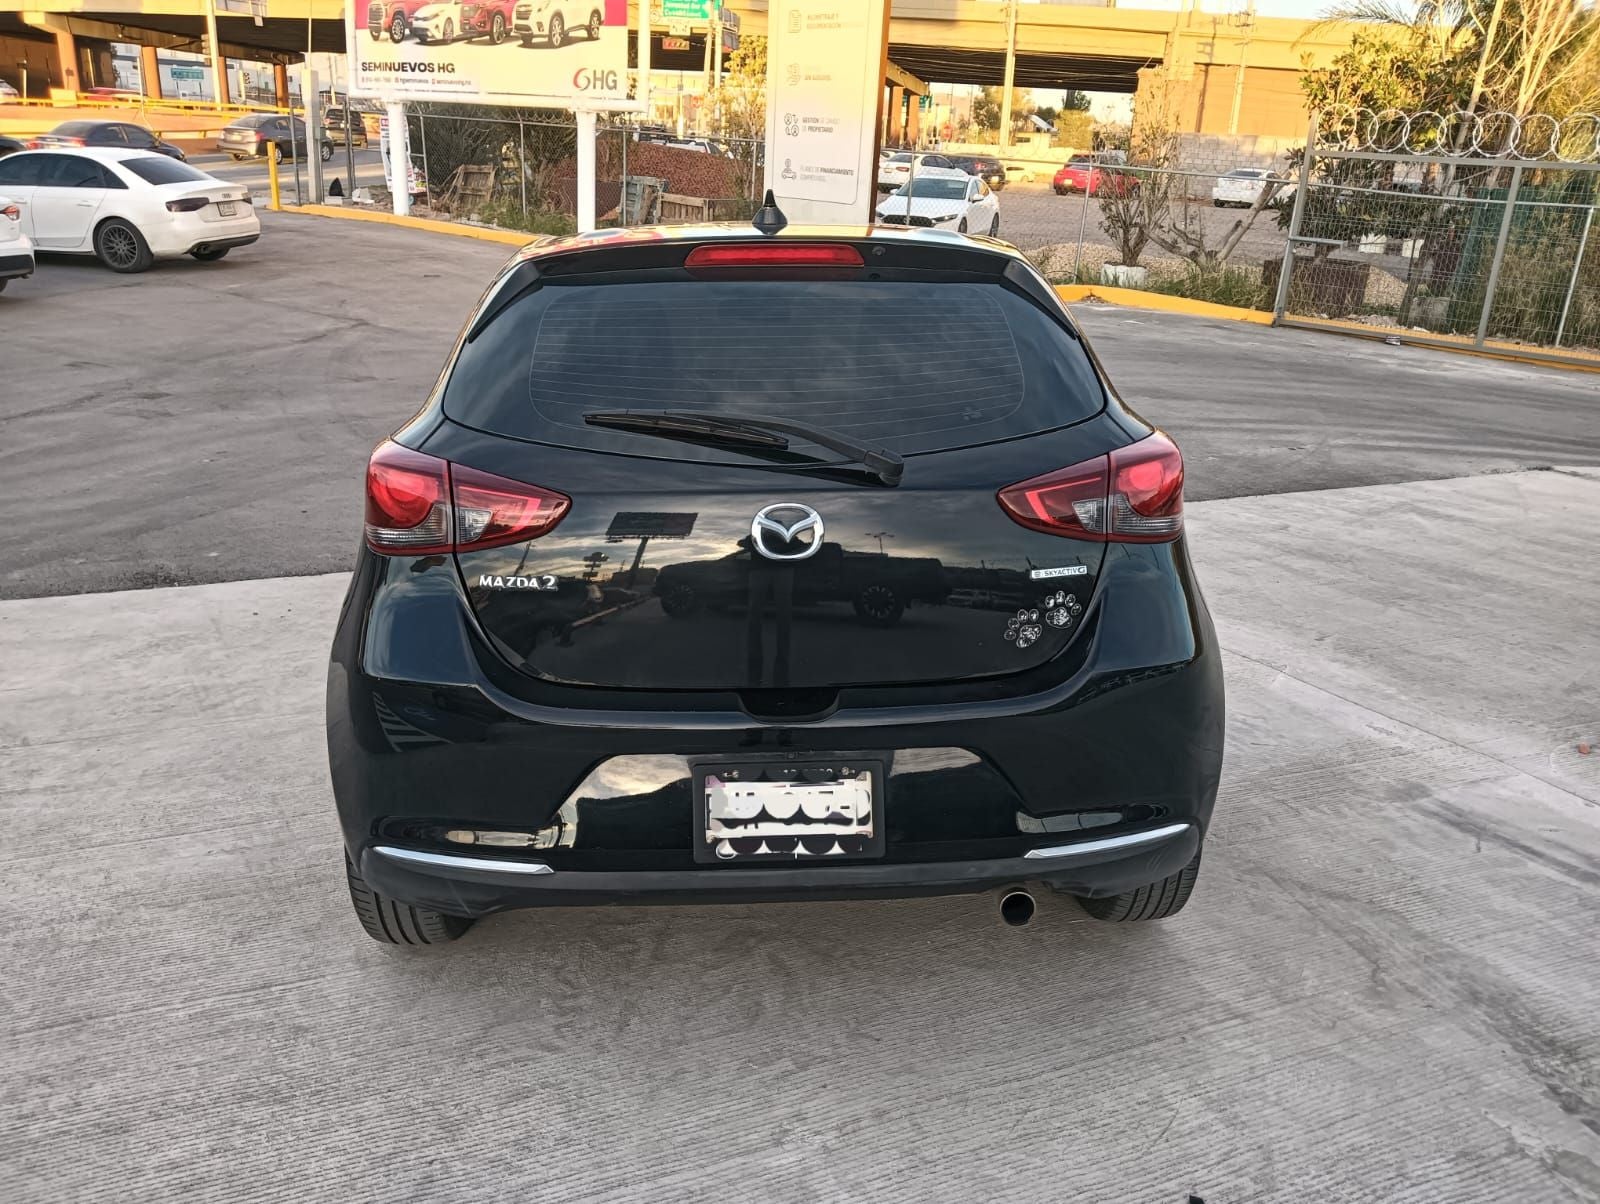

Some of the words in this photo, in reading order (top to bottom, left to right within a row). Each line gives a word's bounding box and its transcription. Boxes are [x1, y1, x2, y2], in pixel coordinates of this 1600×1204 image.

[361, 61, 435, 73] SEMINUEVOS
[437, 62, 456, 74] HG
[593, 69, 618, 91] HG
[479, 574, 540, 590] MAZDA
[542, 575, 558, 591] 2
